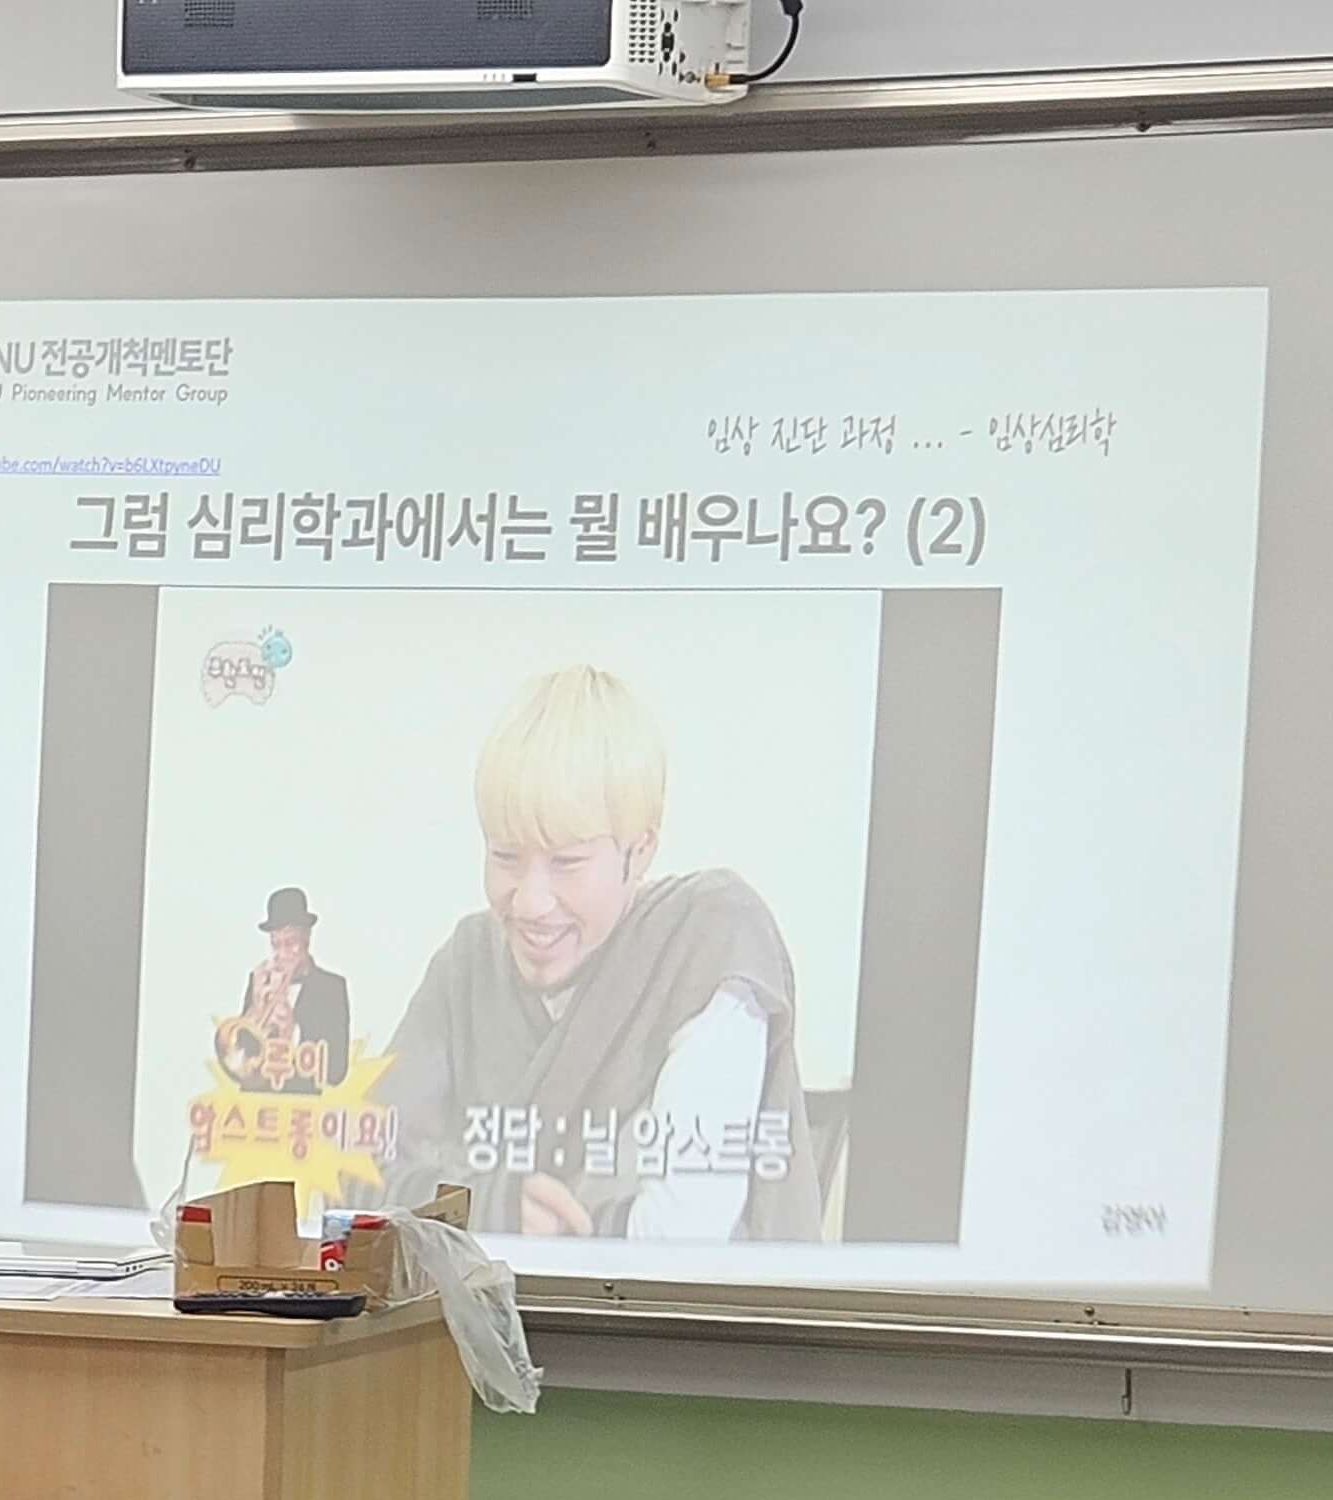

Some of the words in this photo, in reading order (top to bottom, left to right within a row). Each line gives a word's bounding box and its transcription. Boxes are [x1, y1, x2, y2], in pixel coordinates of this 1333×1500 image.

[41, 338, 233, 377] 전공개척멘토단
[12, 383, 97, 406] Pioneering
[106, 385, 166, 404] Mentor
[175, 386, 229, 407] Group
[707, 413, 760, 457] 임상
[771, 417, 828, 455] 진단
[840, 415, 897, 455] 과정
[988, 407, 1118, 458] 임상심리학
[69, 492, 169, 560] 그럼
[186, 492, 553, 563] 심리학과에서는
[569, 492, 620, 563] 뭘
[636, 492, 888, 562] 배우나요?
[906, 496, 987, 567] (2)
[463, 1104, 543, 1173] 정답
[581, 1106, 620, 1176] 닐
[632, 1108, 792, 1181] 암스트롱
